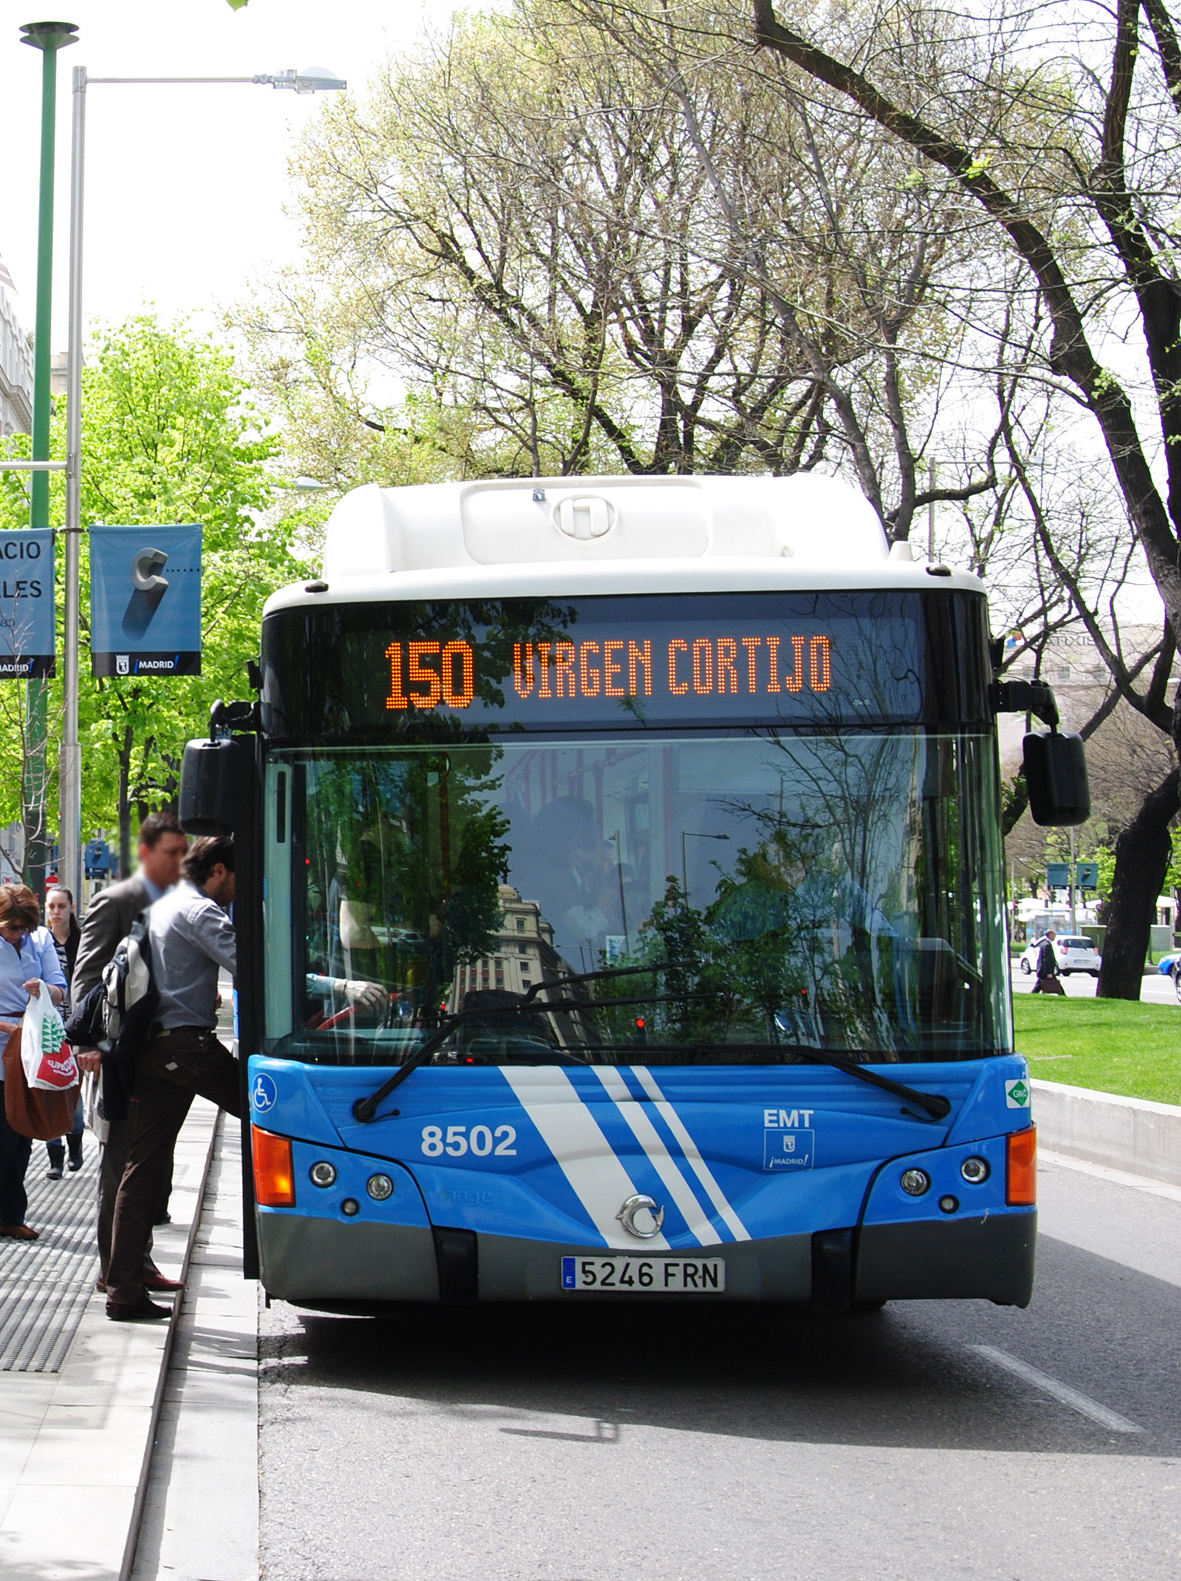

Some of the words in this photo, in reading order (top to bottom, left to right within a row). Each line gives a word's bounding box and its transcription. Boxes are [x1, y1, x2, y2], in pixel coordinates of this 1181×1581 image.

[384, 640, 474, 709] 150
[513, 639, 652, 698] VIRGEN
[668, 635, 831, 695] CORTIJO
[763, 1109, 815, 1128] EMT
[421, 1124, 518, 1157] 8502
[565, 1276, 573, 1284] E
[581, 1261, 654, 1288] 5246
[664, 1262, 718, 1288] FRN
